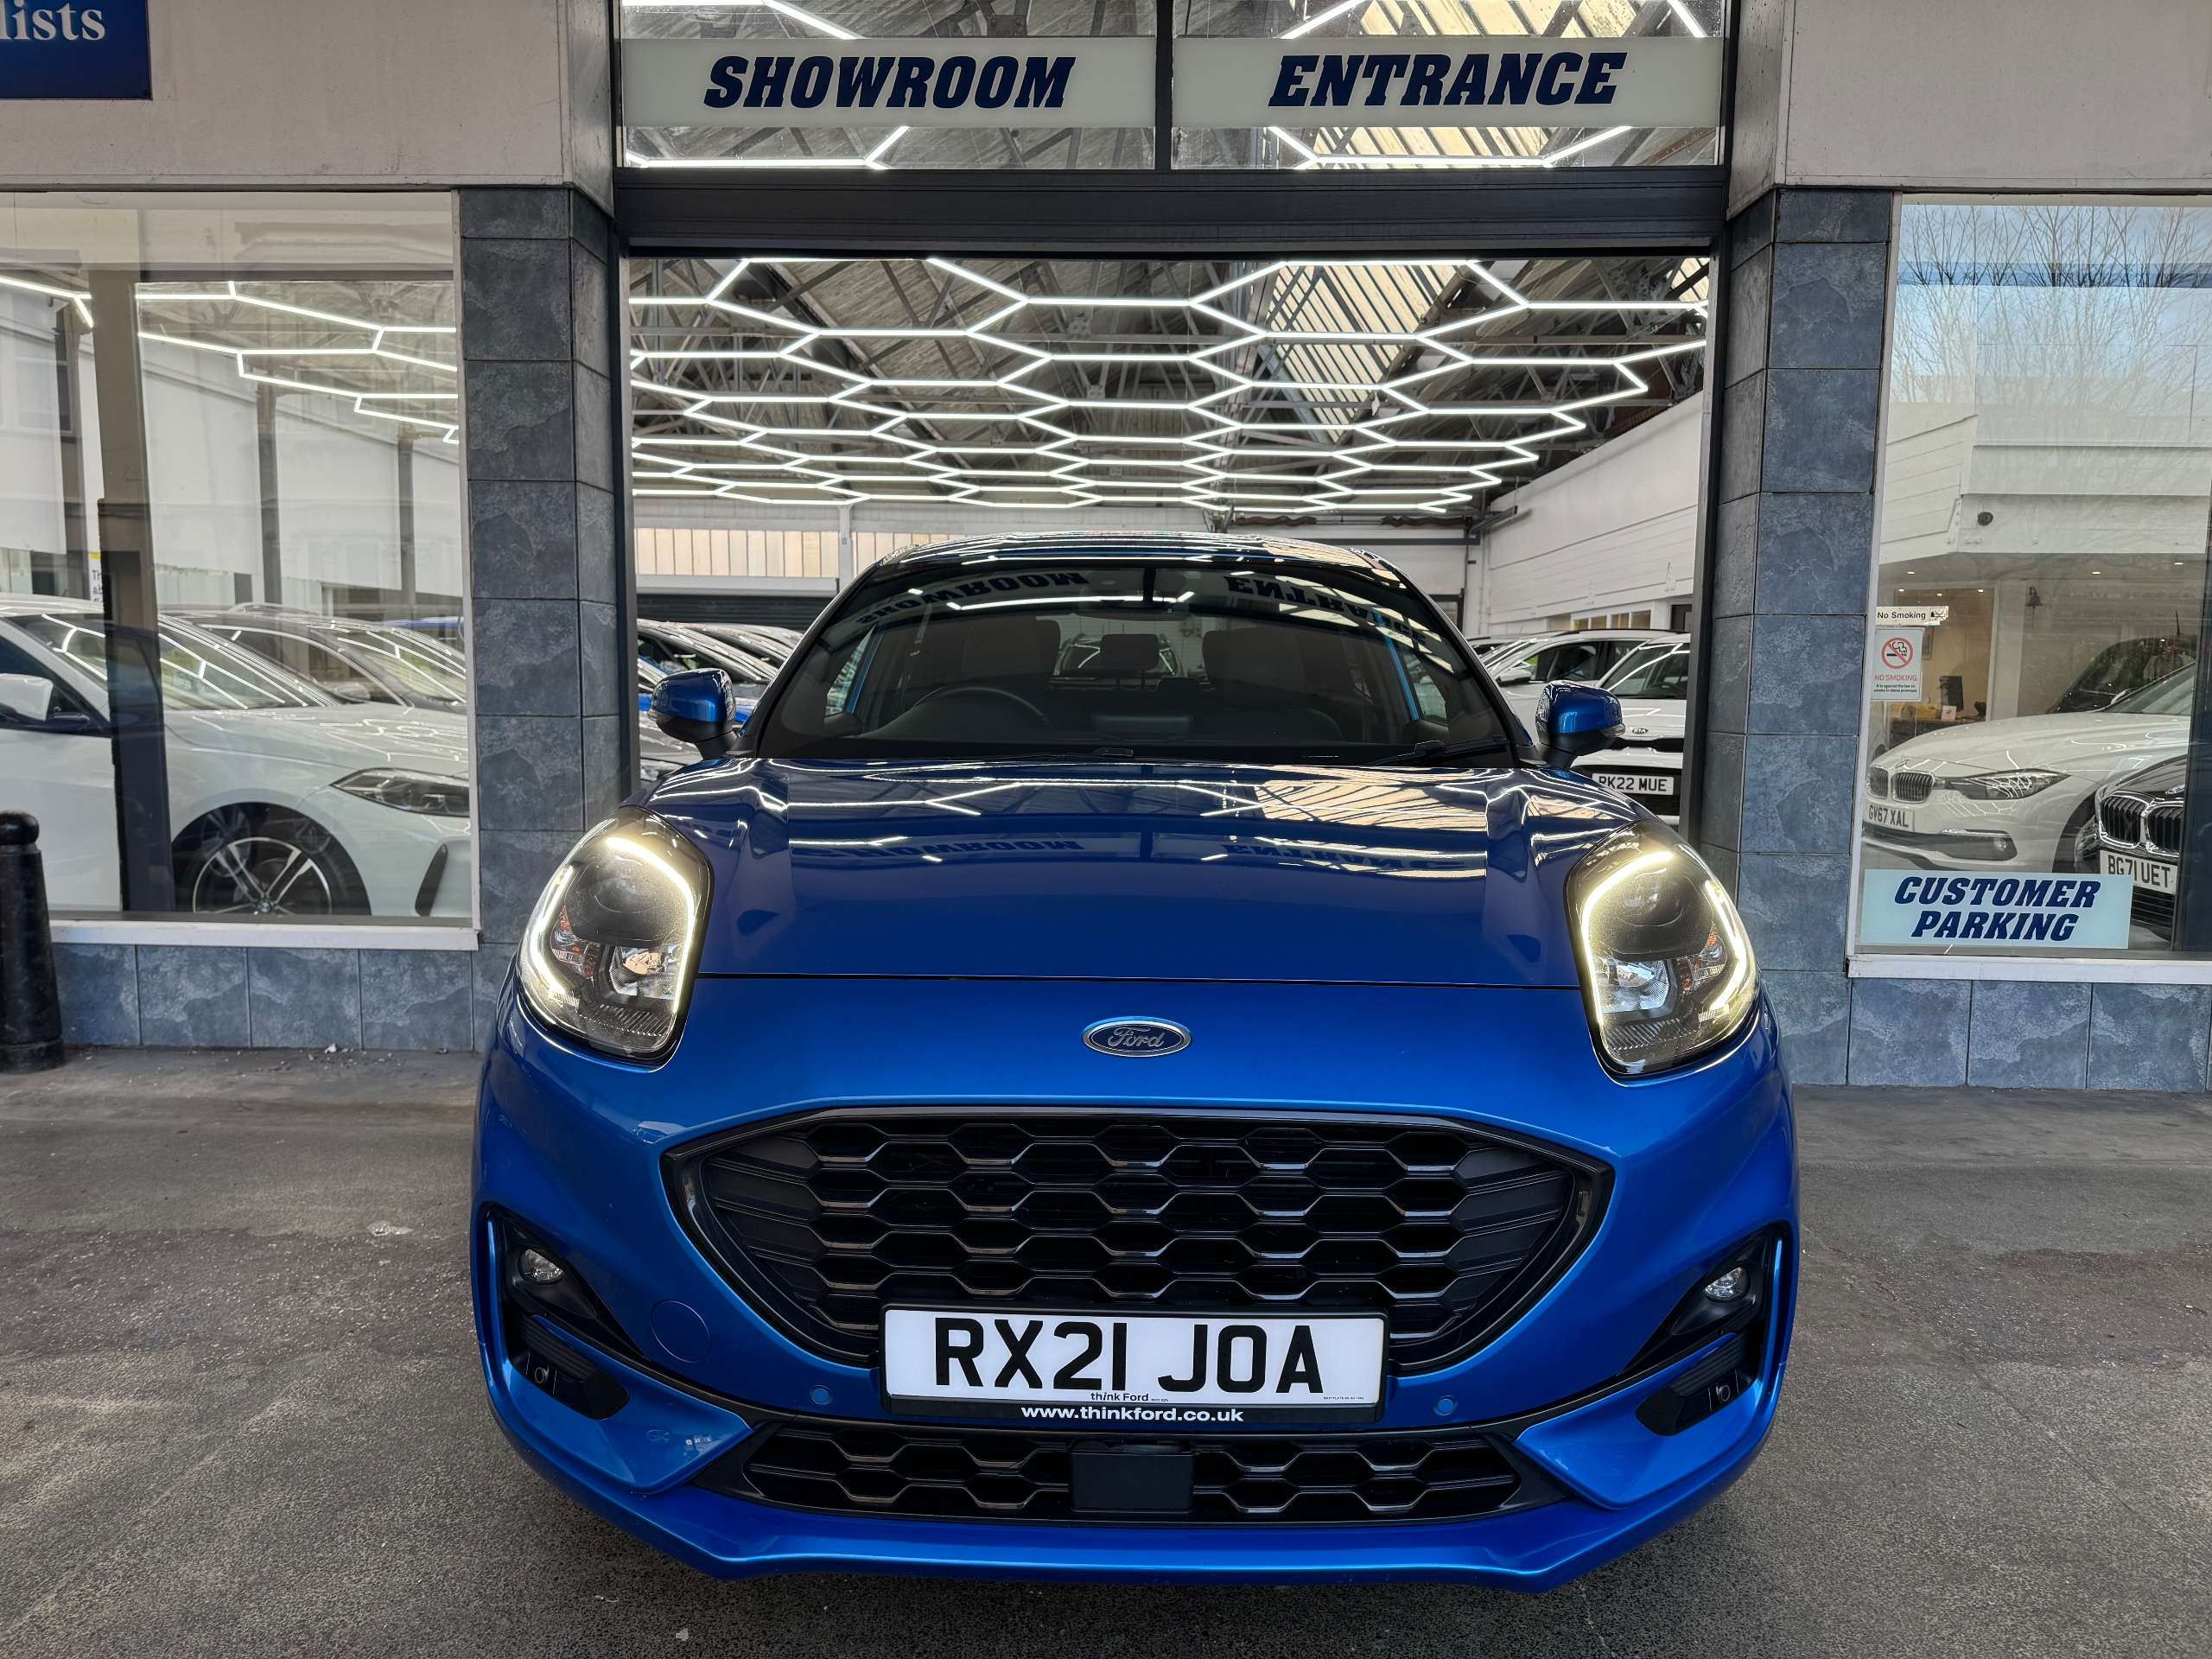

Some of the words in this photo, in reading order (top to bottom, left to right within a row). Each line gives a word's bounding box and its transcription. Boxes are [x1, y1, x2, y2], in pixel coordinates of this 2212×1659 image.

[703, 55, 1076, 109] SHOWROOM
[1268, 52, 1627, 106] ENTRANCE
[1891, 611, 1926, 620] Smoking
[1638, 778, 1668, 791] MUE
[1890, 809, 1909, 828] XAL
[2140, 861, 2171, 888] UET
[1894, 876, 2101, 908] CUSTOMER
[1911, 910, 2079, 941] PARKING
[1107, 1027, 1166, 1047] Ford
[934, 1317, 1128, 1391] RX21
[1158, 1324, 1324, 1394] JOA
[1090, 1392, 1121, 1402] think
[1122, 1393, 1149, 1402] Ford
[1020, 1404, 1244, 1422] www.thinkford.co.uk
